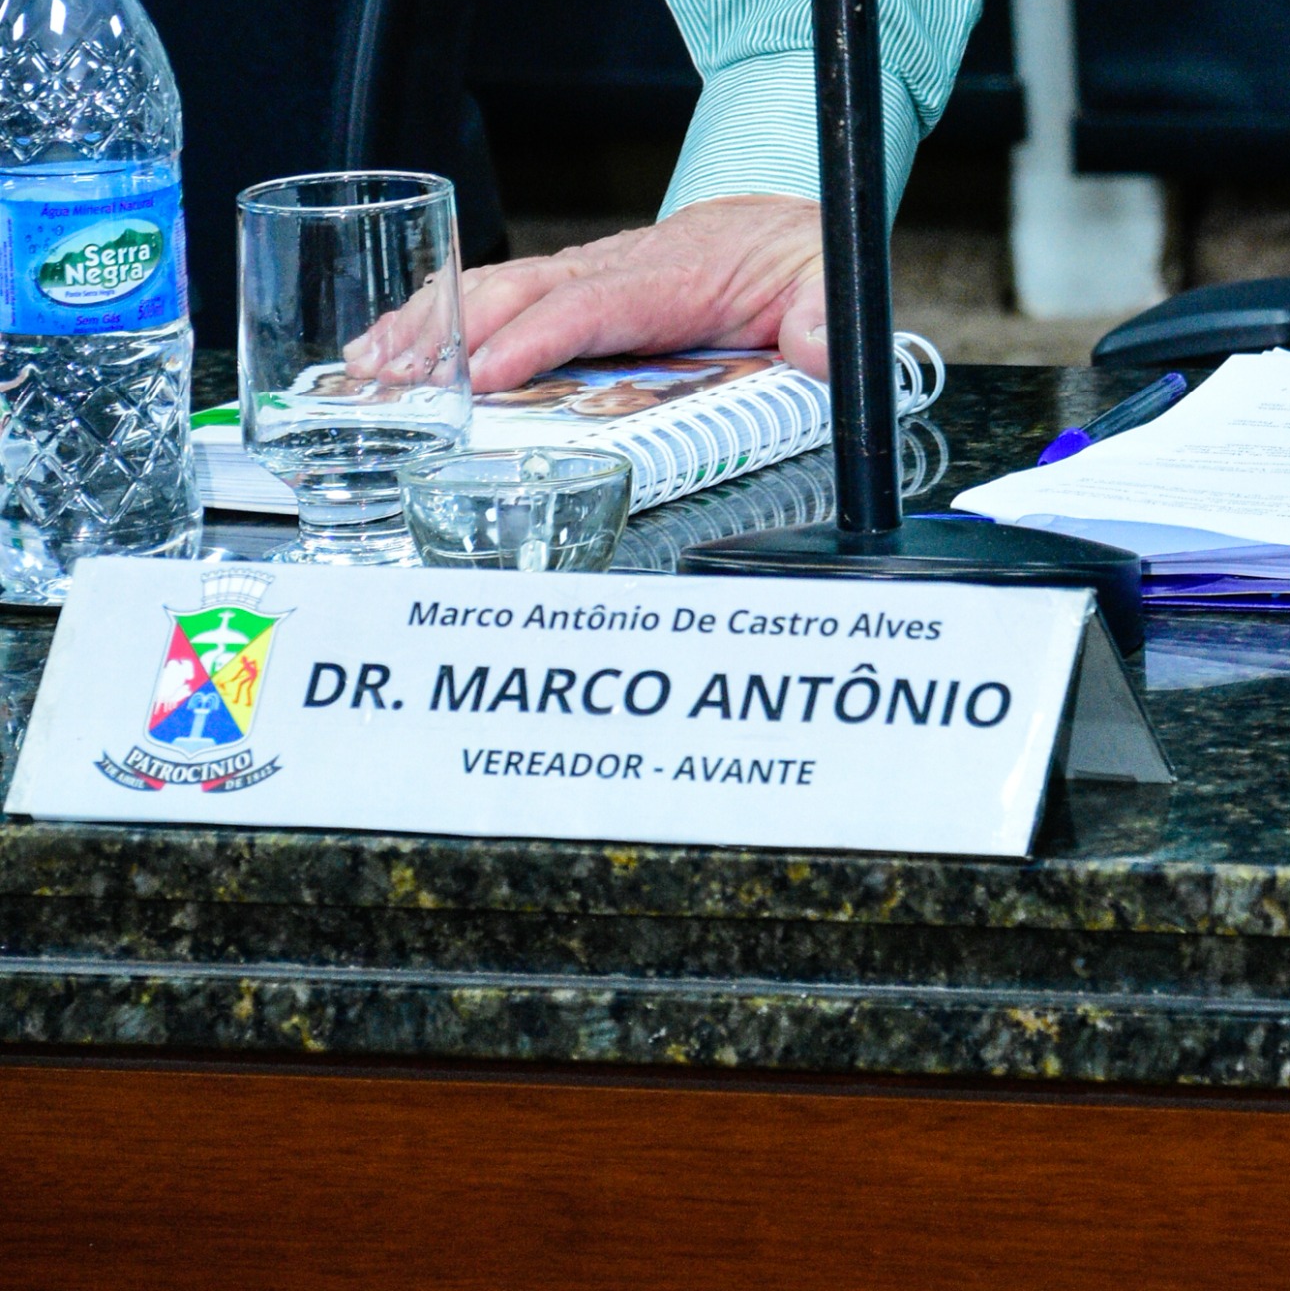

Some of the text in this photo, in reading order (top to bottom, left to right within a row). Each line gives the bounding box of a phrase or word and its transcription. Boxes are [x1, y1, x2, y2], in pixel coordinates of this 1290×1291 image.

[41, 202, 70, 219] Água
[73, 202, 116, 216] Mineral
[84, 243, 153, 267] Serra
[65, 261, 146, 289] Negra
[75, 315, 99, 326] Sem
[409, 601, 942, 640] Marco Antônio De Castro Alves
[303, 662, 1012, 728] DR. MARCO ANTÔNIO
[463, 749, 643, 778] VEREADOR
[673, 756, 816, 785] AVANTE
